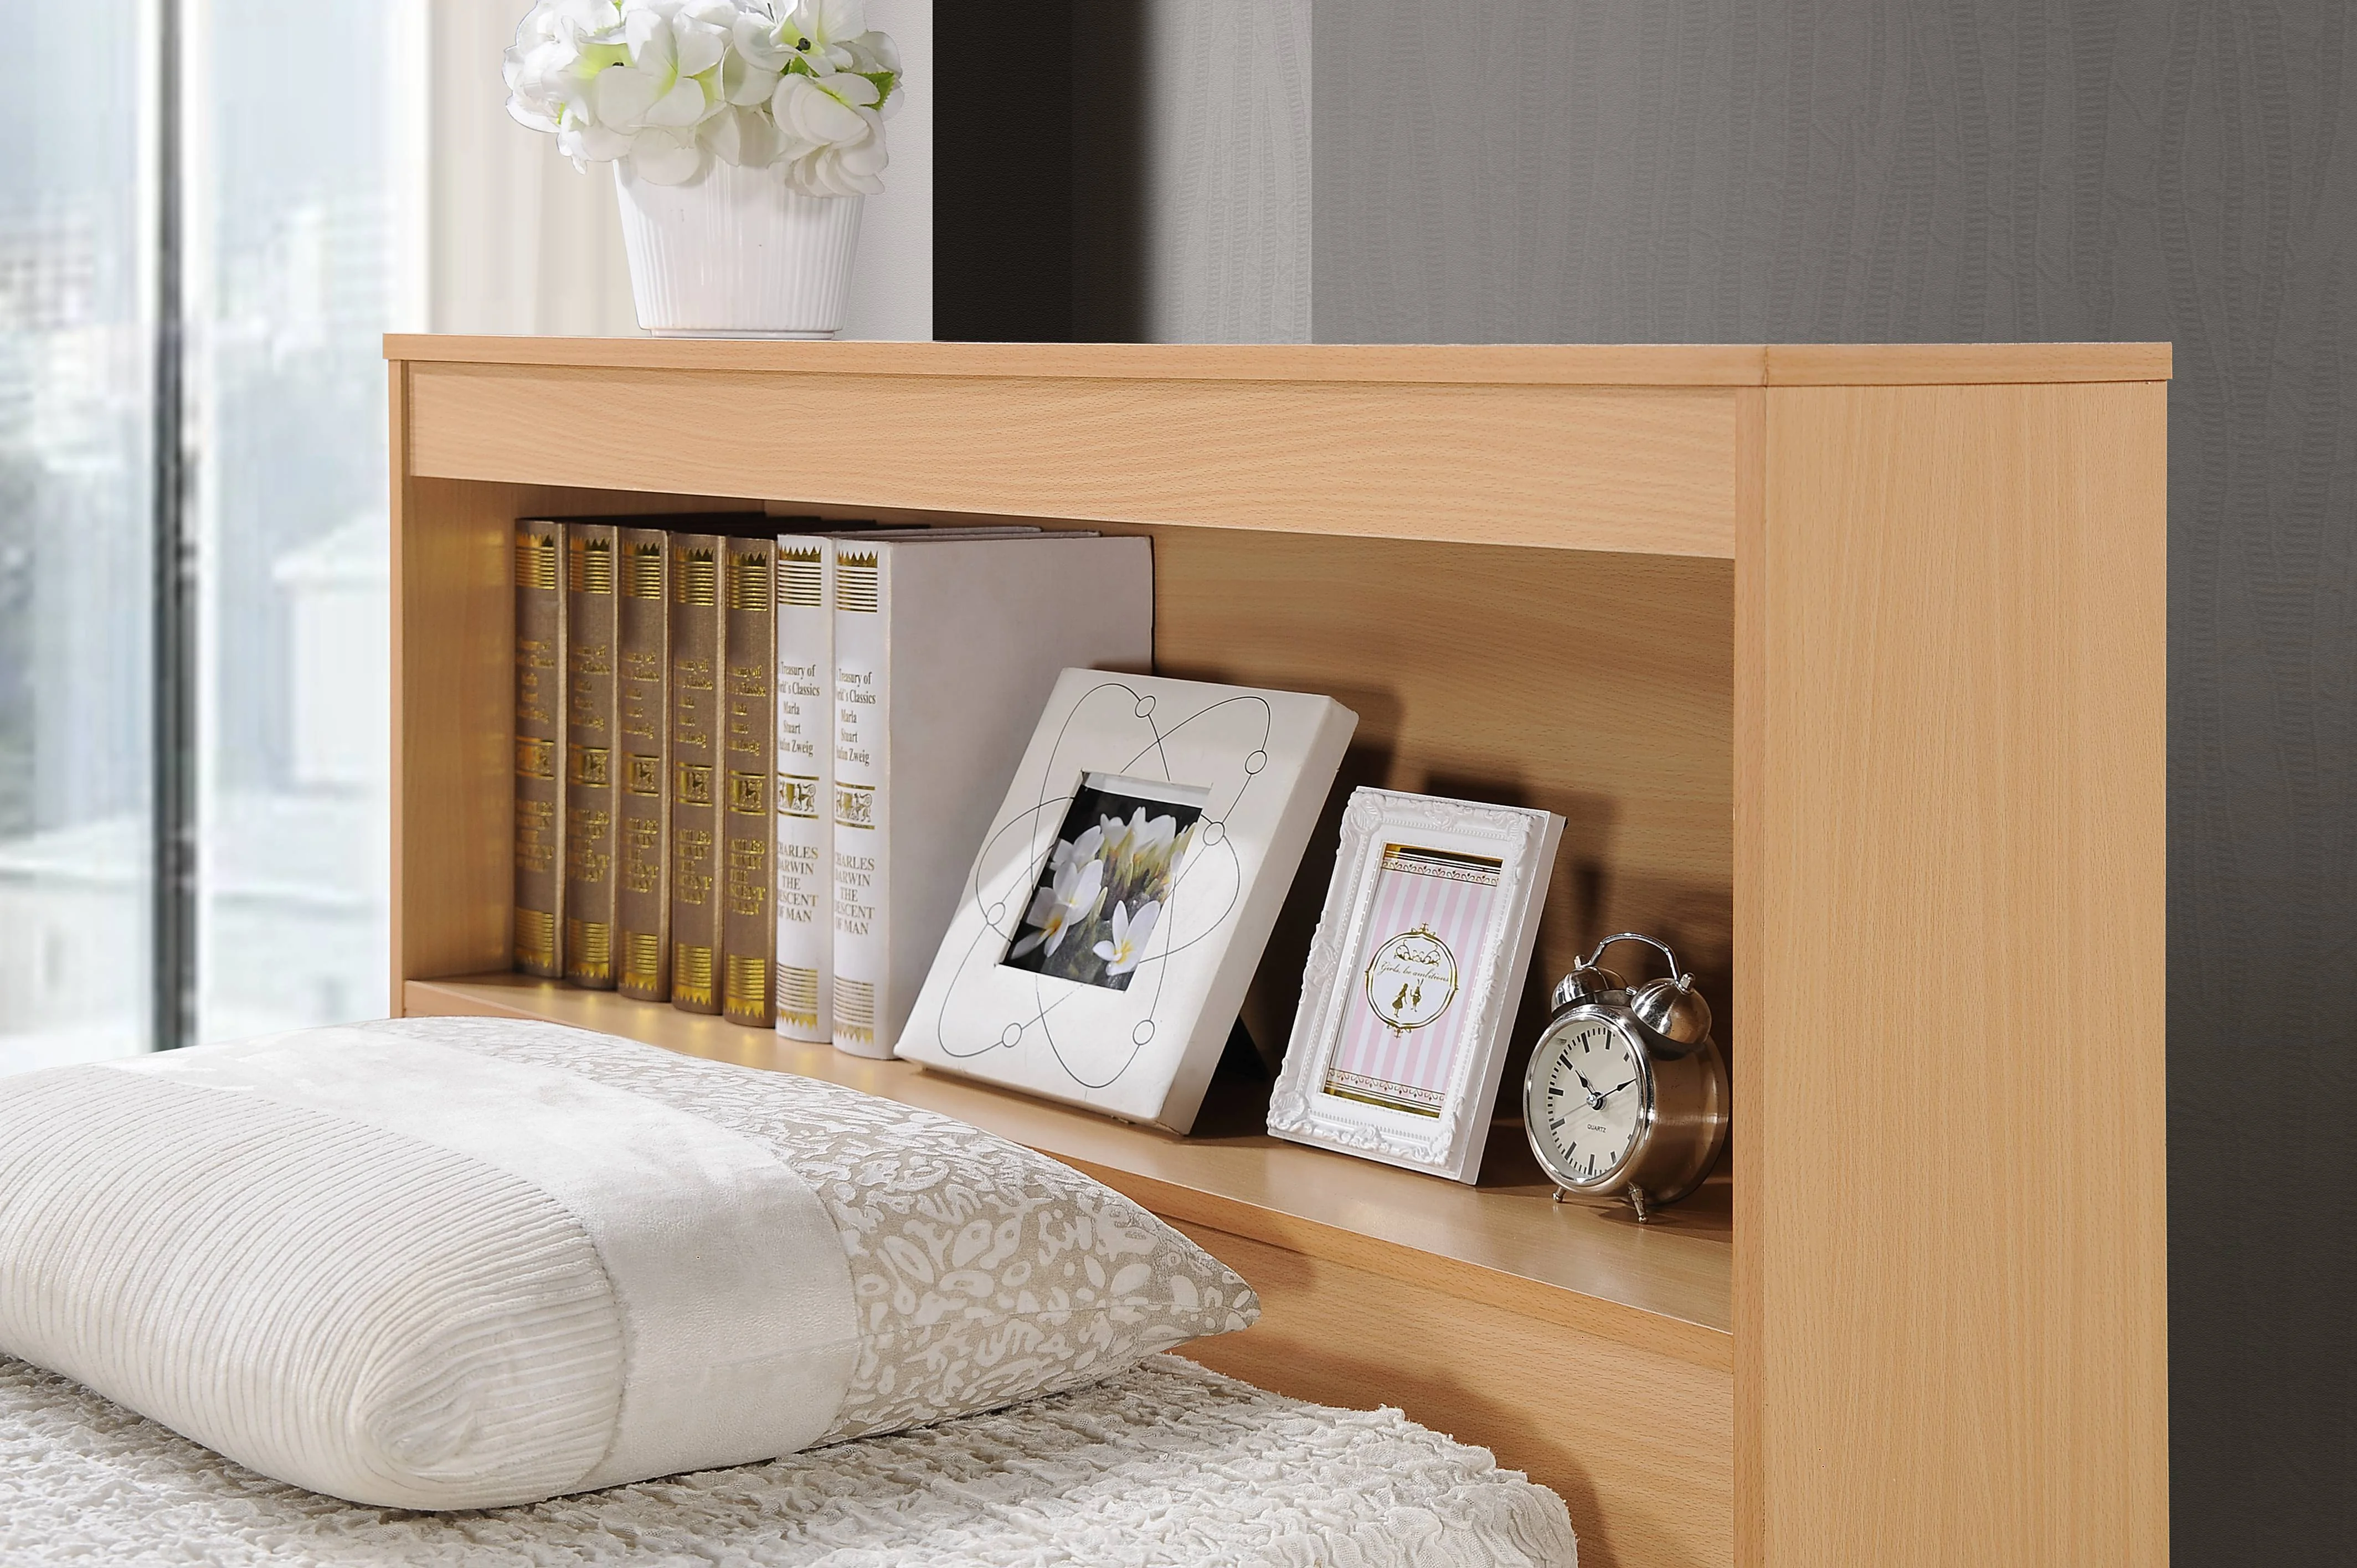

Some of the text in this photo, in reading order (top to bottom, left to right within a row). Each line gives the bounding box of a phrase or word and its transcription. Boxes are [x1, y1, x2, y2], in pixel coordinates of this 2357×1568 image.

[807, 664, 816, 677] of
[863, 671, 872, 685] of
[792, 682, 820, 697] Classics
[850, 689, 877, 705] Classics
[792, 739, 814, 757] Zweig
[849, 747, 870, 767] Zweig
[783, 875, 801, 890] THE
[840, 886, 858, 902] THE
[786, 907, 812, 922] MAN
[843, 918, 869, 935] MAN
[1587, 1124, 1606, 1133] QUARTZ
